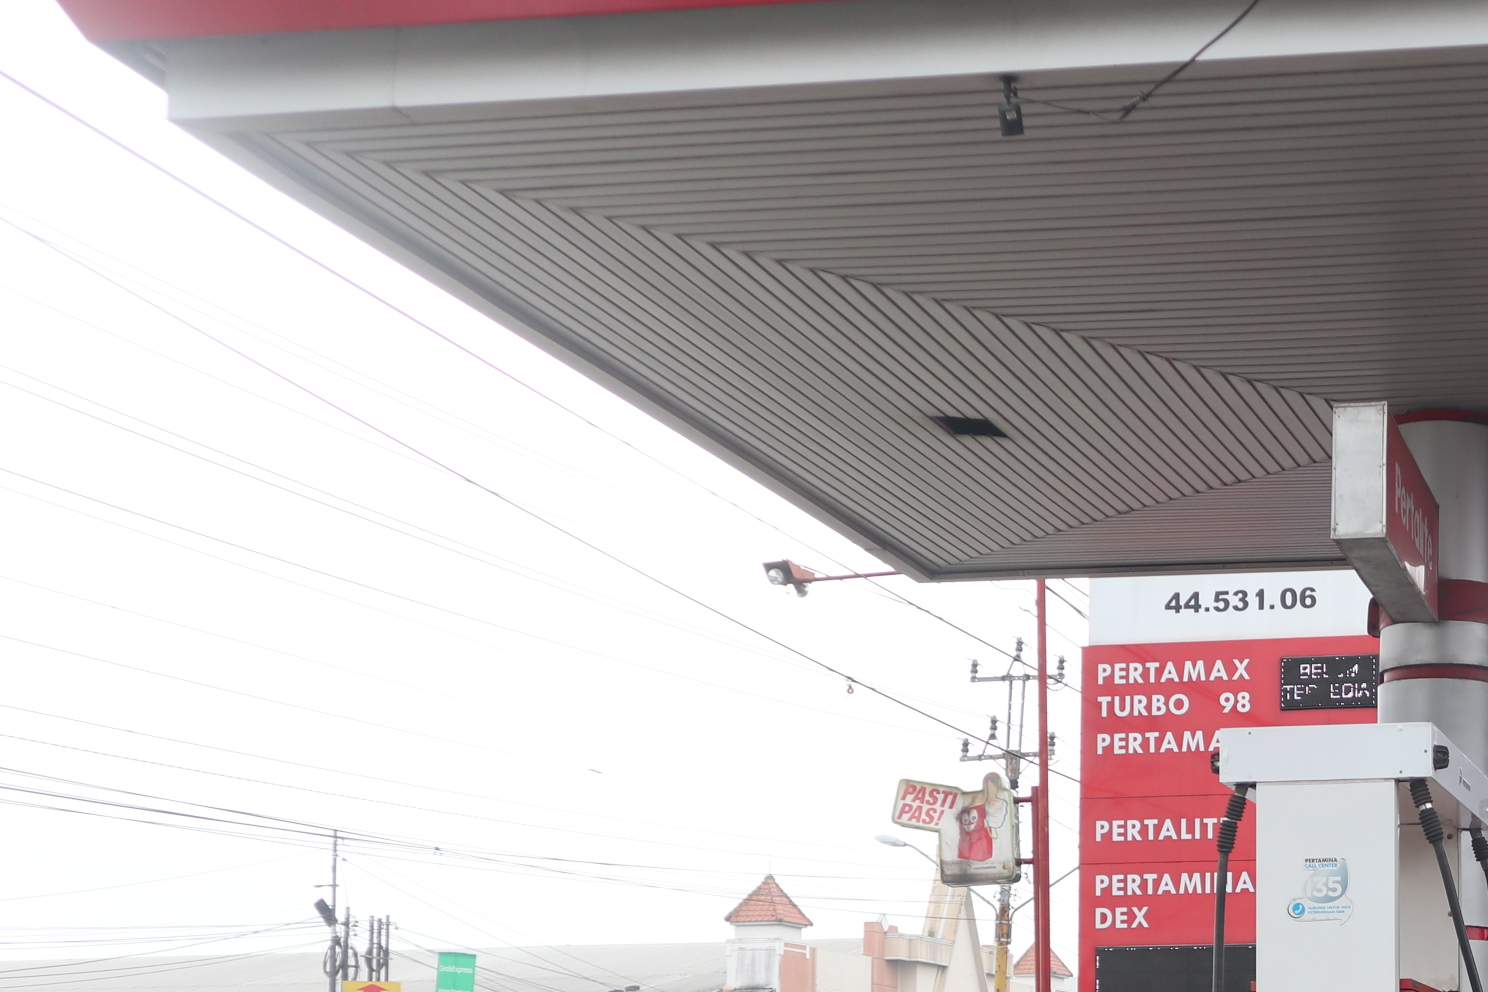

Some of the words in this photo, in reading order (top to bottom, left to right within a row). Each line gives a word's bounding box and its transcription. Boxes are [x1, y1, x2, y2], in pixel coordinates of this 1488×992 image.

[1394, 462, 1434, 570] Pertalite
[1164, 586, 1317, 614] 44.531.06
[1097, 658, 1250, 685] PERTAMAX
[1097, 693, 1190, 717] TURBO
[1219, 691, 1251, 714] 98
[900, 783, 959, 810] PASTI
[896, 802, 946, 827] PAS!
[1095, 817, 1229, 842] PERTALIT
[1306, 876, 1343, 898] 135
[1095, 906, 1150, 930] DEX
